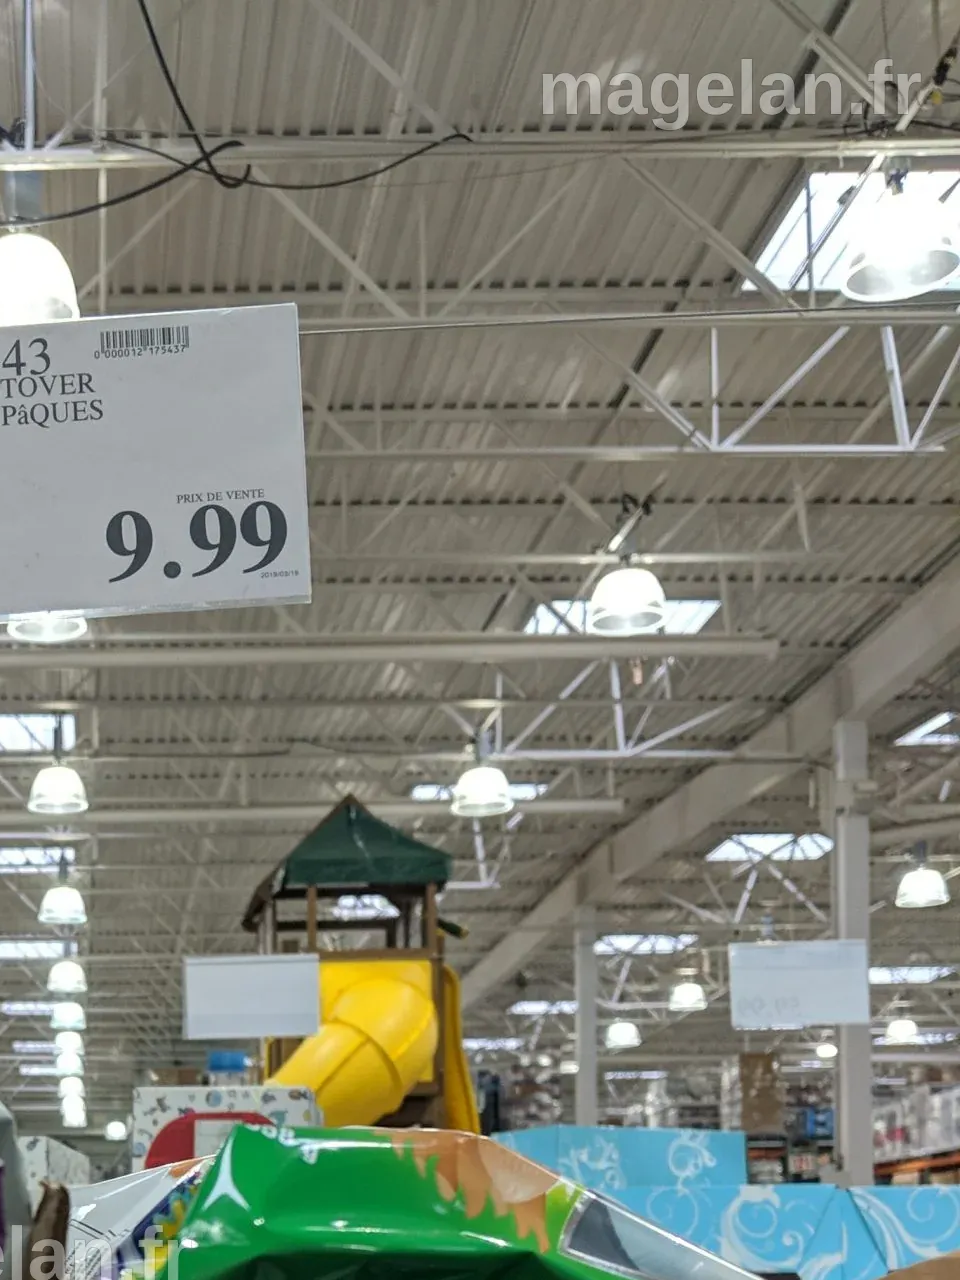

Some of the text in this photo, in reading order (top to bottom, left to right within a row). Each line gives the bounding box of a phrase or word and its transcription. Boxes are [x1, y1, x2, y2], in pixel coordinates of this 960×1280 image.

[2, 399, 104, 429] PâQUES
[176, 488, 265, 504] PRIX DE VENTE
[105, 500, 288, 584] 9.99
